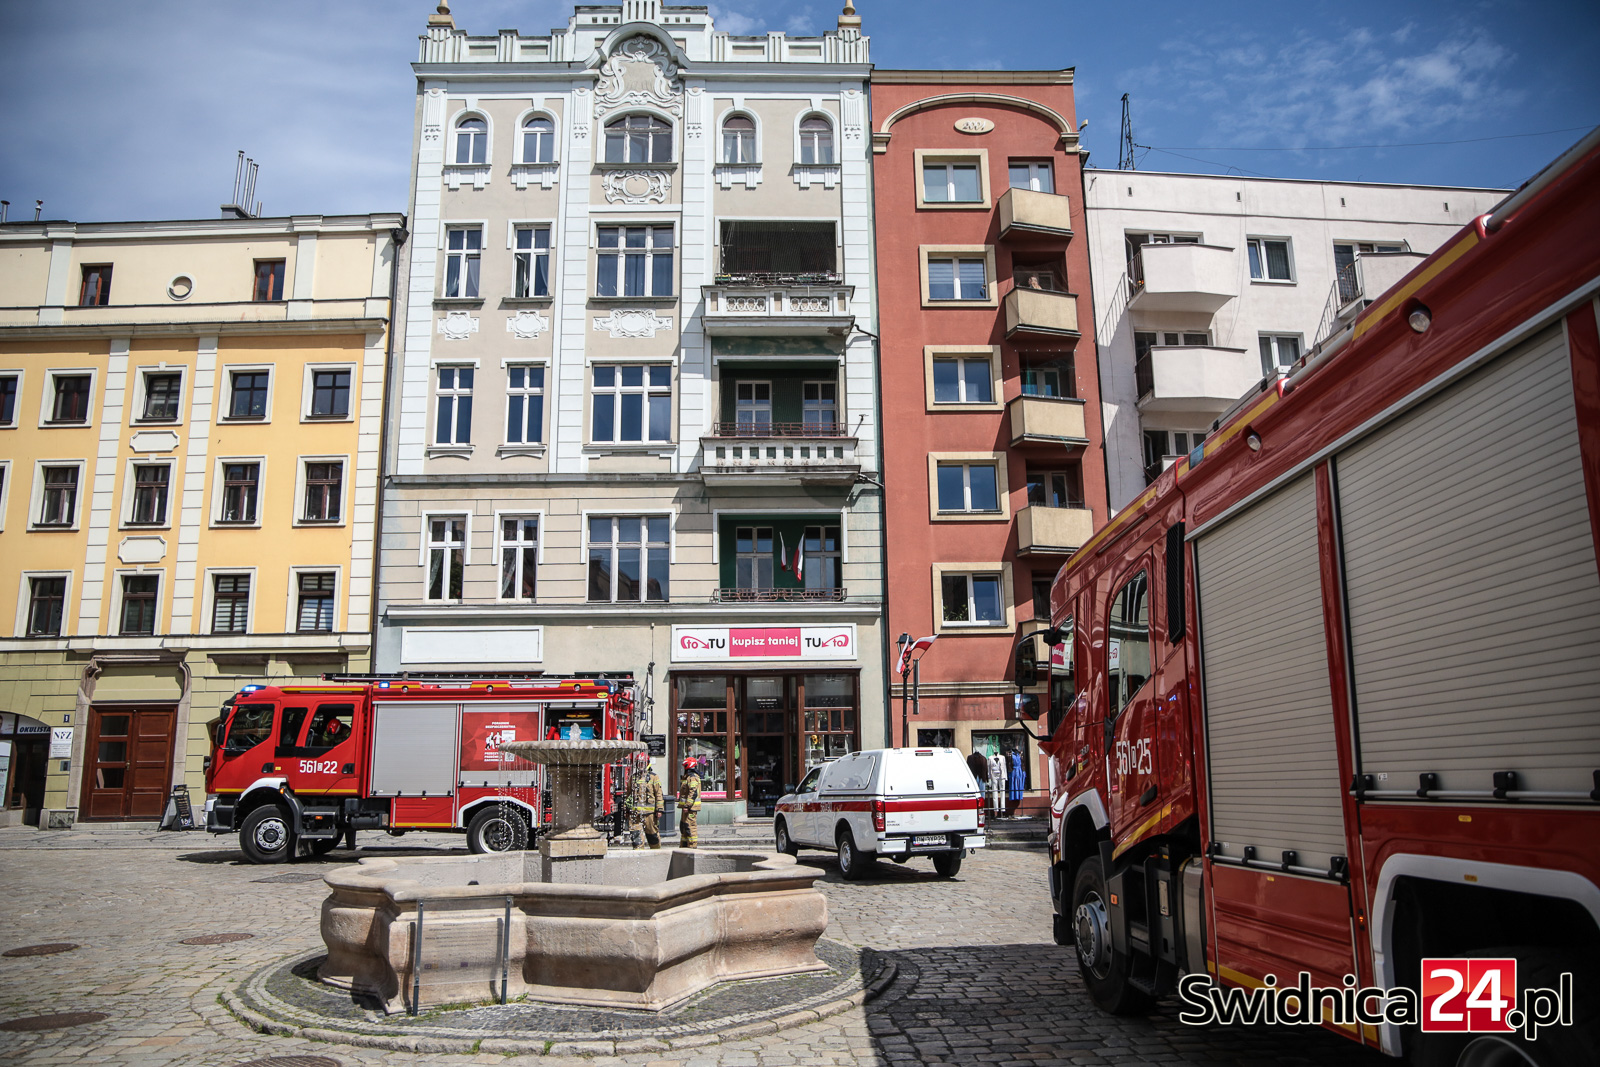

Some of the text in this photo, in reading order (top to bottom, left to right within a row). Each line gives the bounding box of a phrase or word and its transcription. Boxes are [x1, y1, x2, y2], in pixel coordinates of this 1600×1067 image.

[708, 638, 725, 649] TU
[732, 636, 765, 647] kupisz
[768, 636, 798, 647] taniej
[805, 637, 821, 648] TU
[54, 731, 72, 740] NFZ
